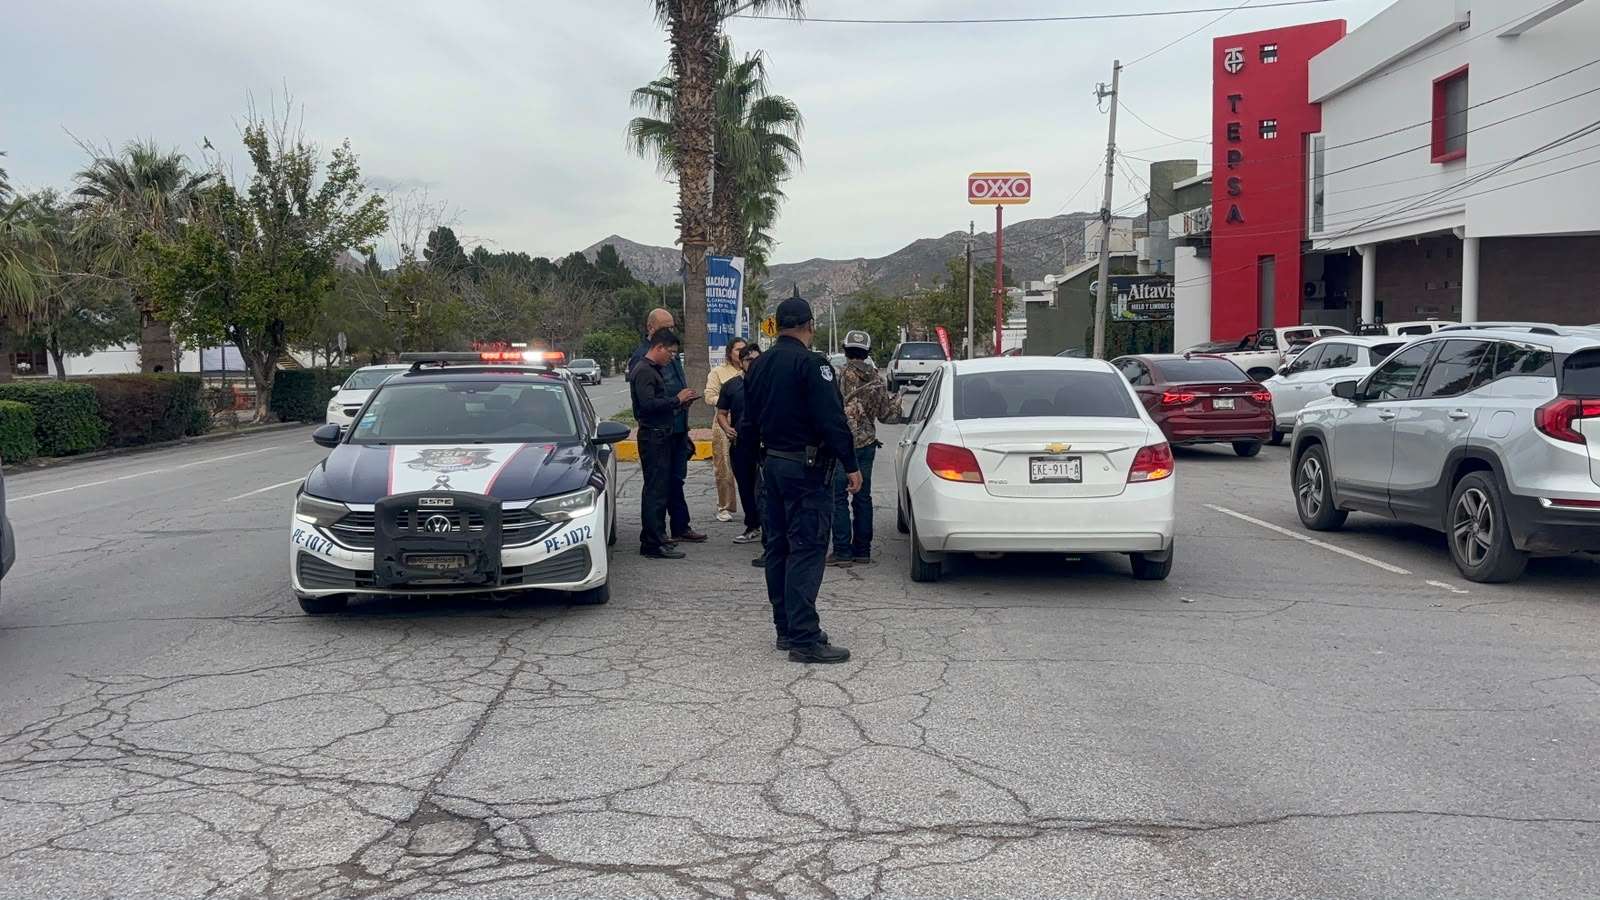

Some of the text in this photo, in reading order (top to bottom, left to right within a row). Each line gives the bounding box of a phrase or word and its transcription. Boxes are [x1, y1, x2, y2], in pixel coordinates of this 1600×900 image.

[1227, 94, 1244, 225] TEPSA
[971, 179, 1029, 197] OXXO
[1032, 463, 1080, 476] EKE-911-A
[292, 528, 334, 556] PE-1072
[544, 525, 592, 553] PE-1072
